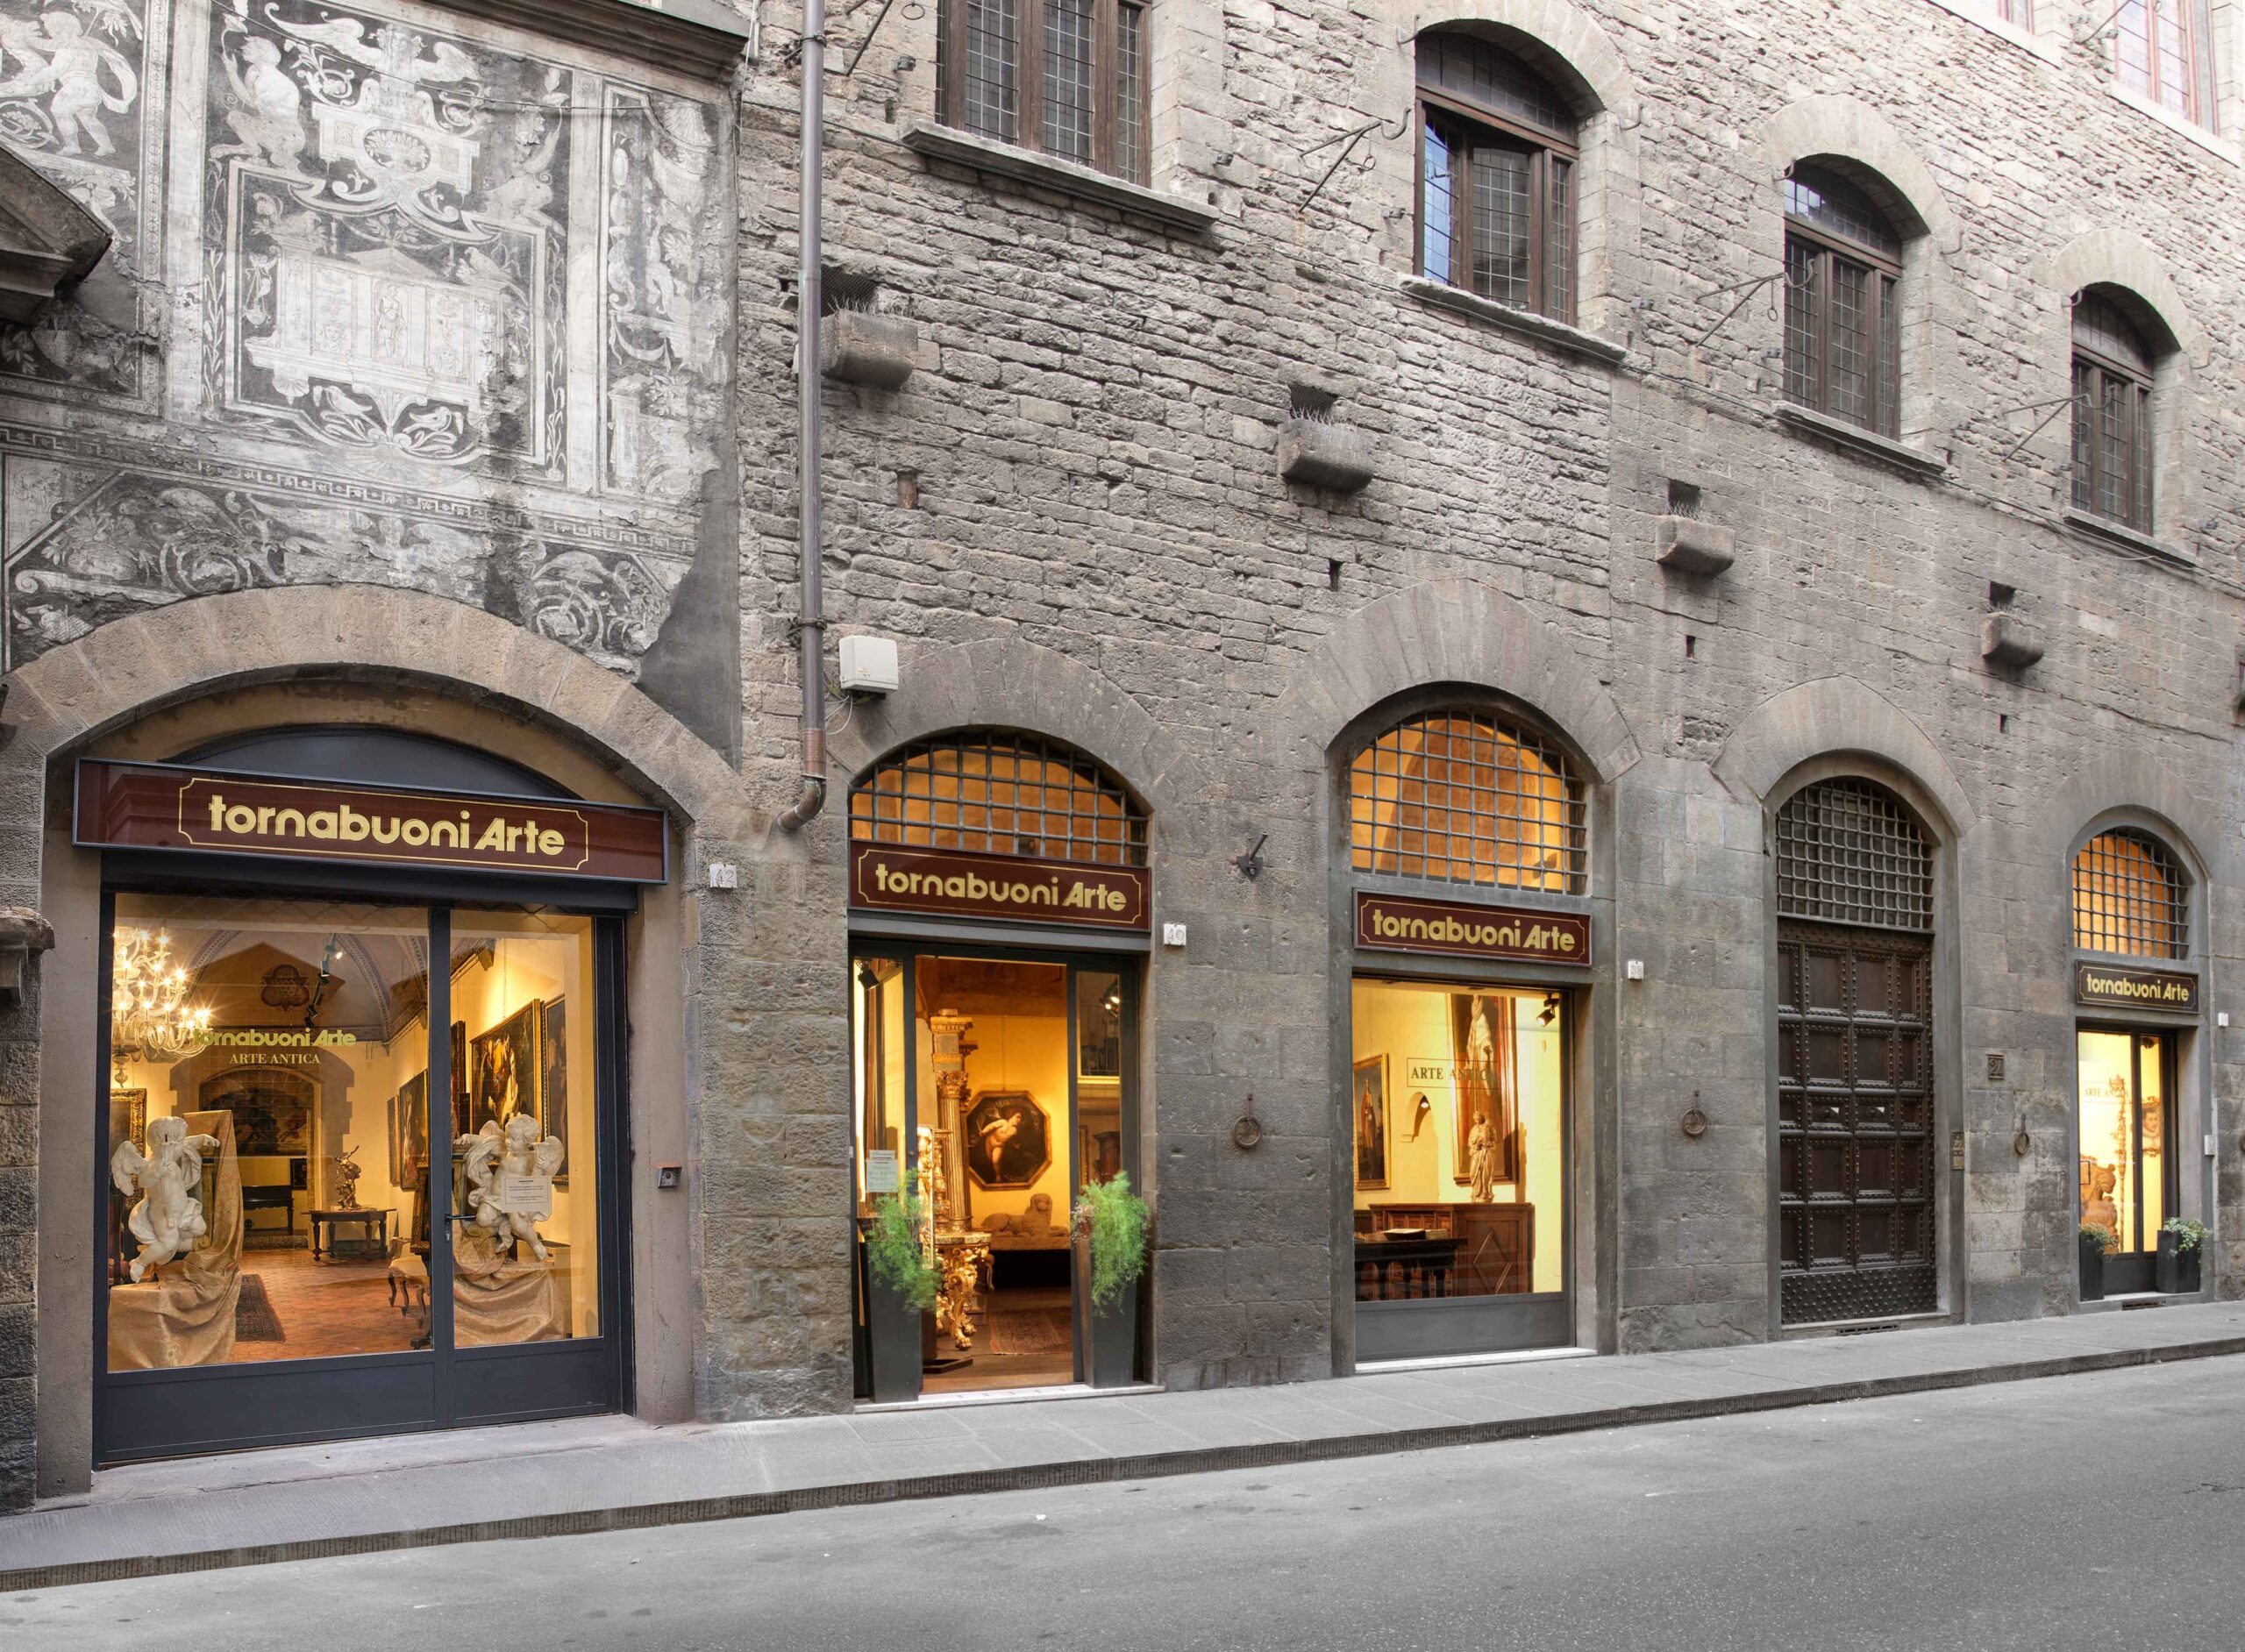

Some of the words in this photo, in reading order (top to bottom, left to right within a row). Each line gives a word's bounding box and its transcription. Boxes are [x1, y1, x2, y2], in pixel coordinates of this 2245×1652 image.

[209, 794, 469, 849] tornabuoni
[474, 817, 566, 856] Arte
[716, 869, 735, 884] 42
[875, 864, 1058, 906] tornabuoni
[1062, 882, 1127, 911] Arte
[1166, 929, 1185, 941] 40
[1373, 909, 1521, 947] tornabuoni
[1522, 924, 1576, 951] Arte
[2087, 973, 2161, 999] tornabuoni
[2163, 983, 2189, 1001] Arte
[193, 1028, 310, 1046] tornabuoni
[312, 1029, 356, 1046] Arte
[229, 1053, 267, 1064] ARTE
[270, 1054, 320, 1064] ANTICA
[1411, 1066, 1443, 1079] ARTE
